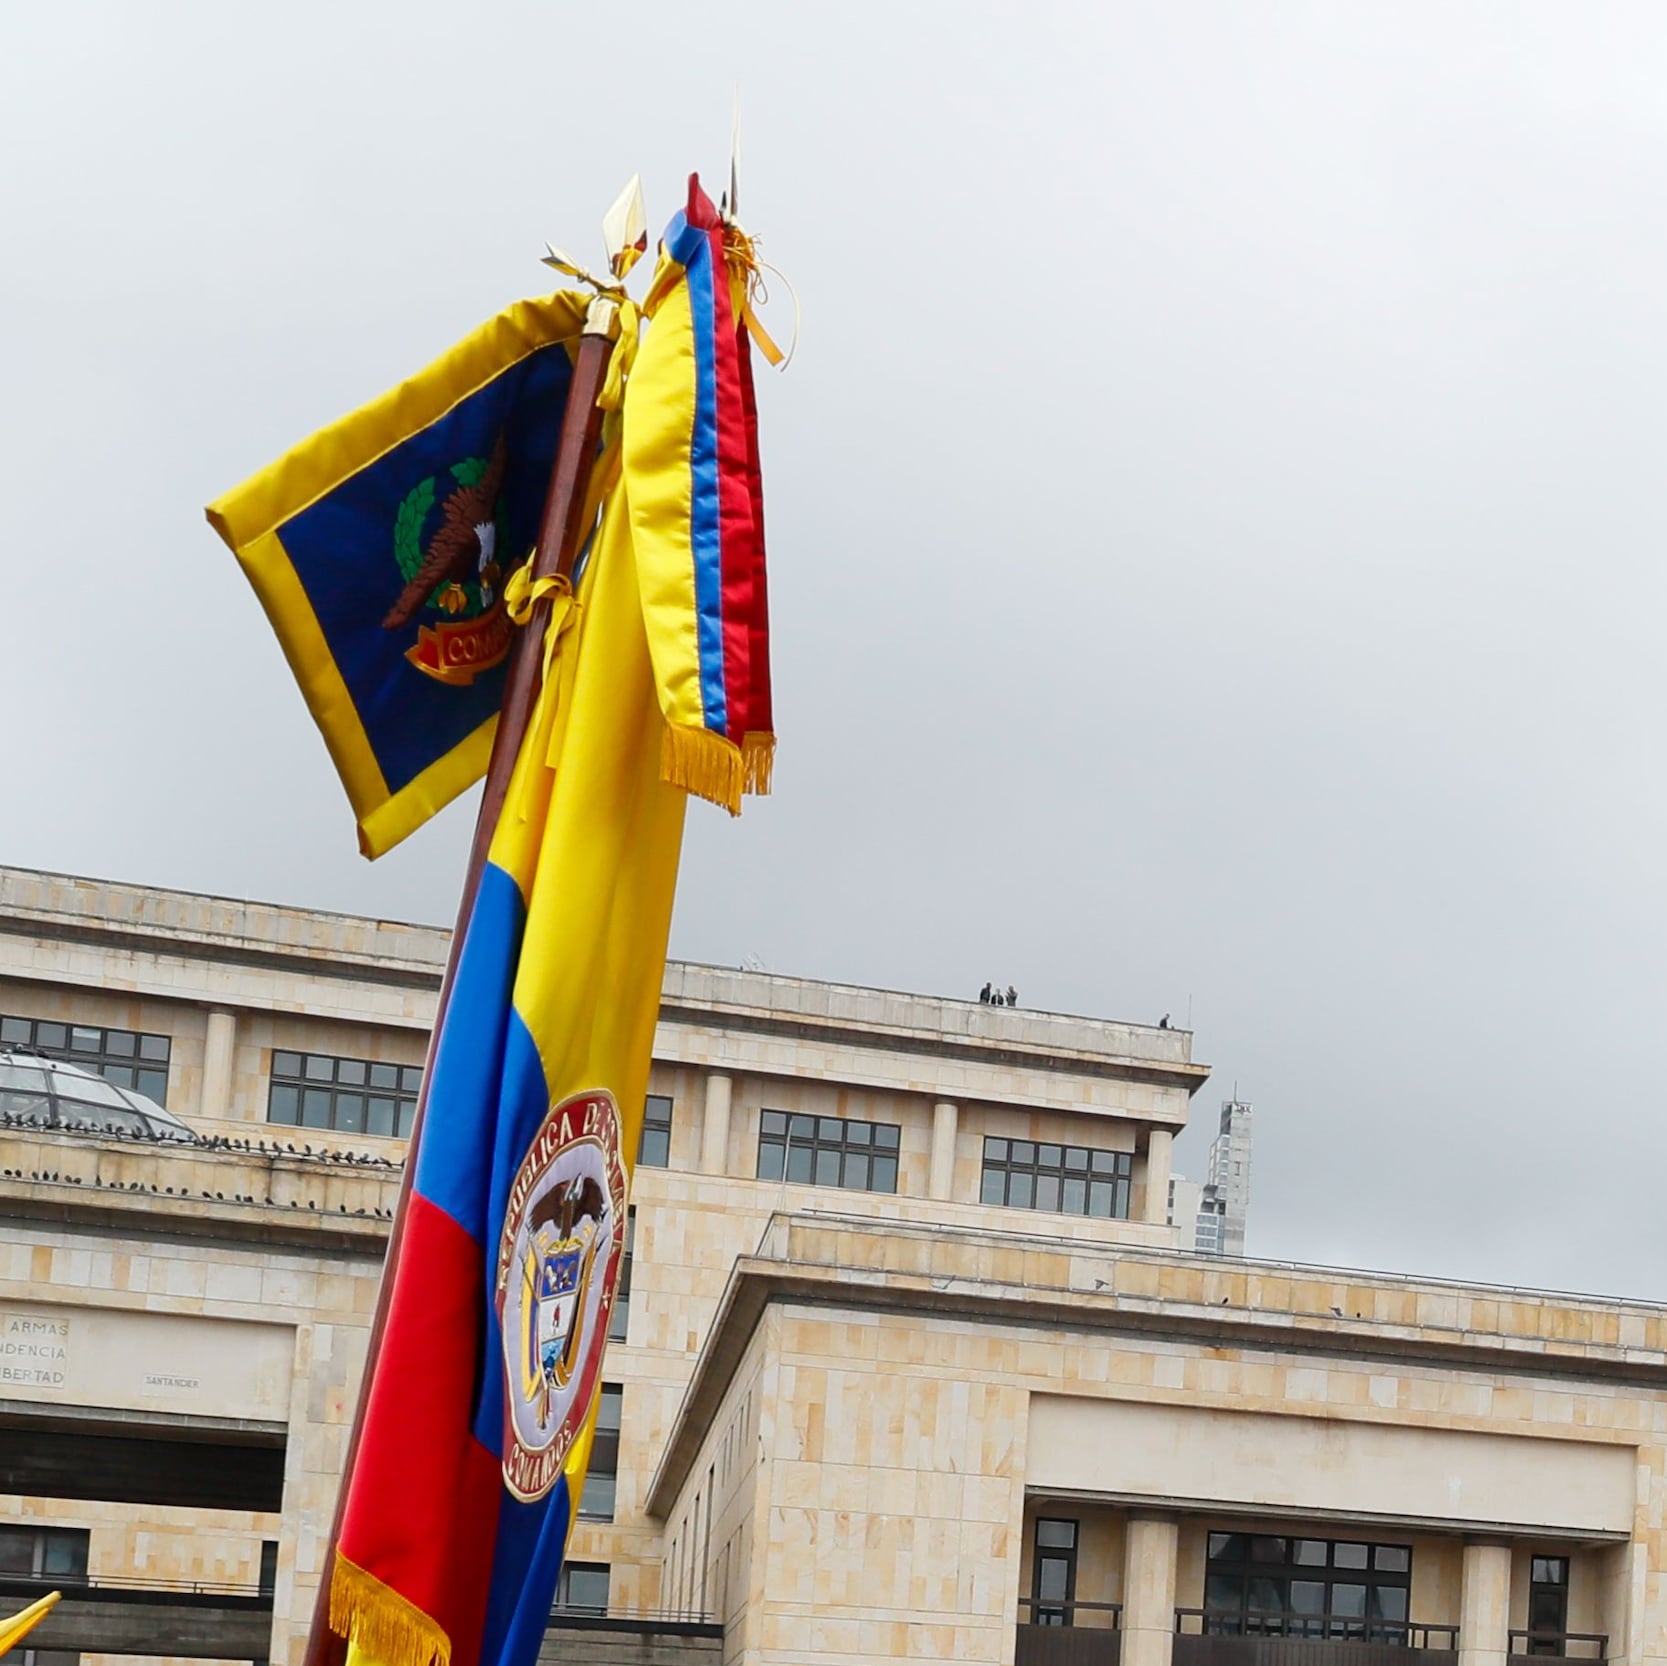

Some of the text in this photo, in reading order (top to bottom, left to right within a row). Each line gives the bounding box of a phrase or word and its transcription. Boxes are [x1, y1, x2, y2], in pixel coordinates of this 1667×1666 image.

[10, 1321, 69, 1336] ARMAS
[0, 1368, 64, 1384] BERTAD
[145, 1375, 200, 1388] SANTANDER
